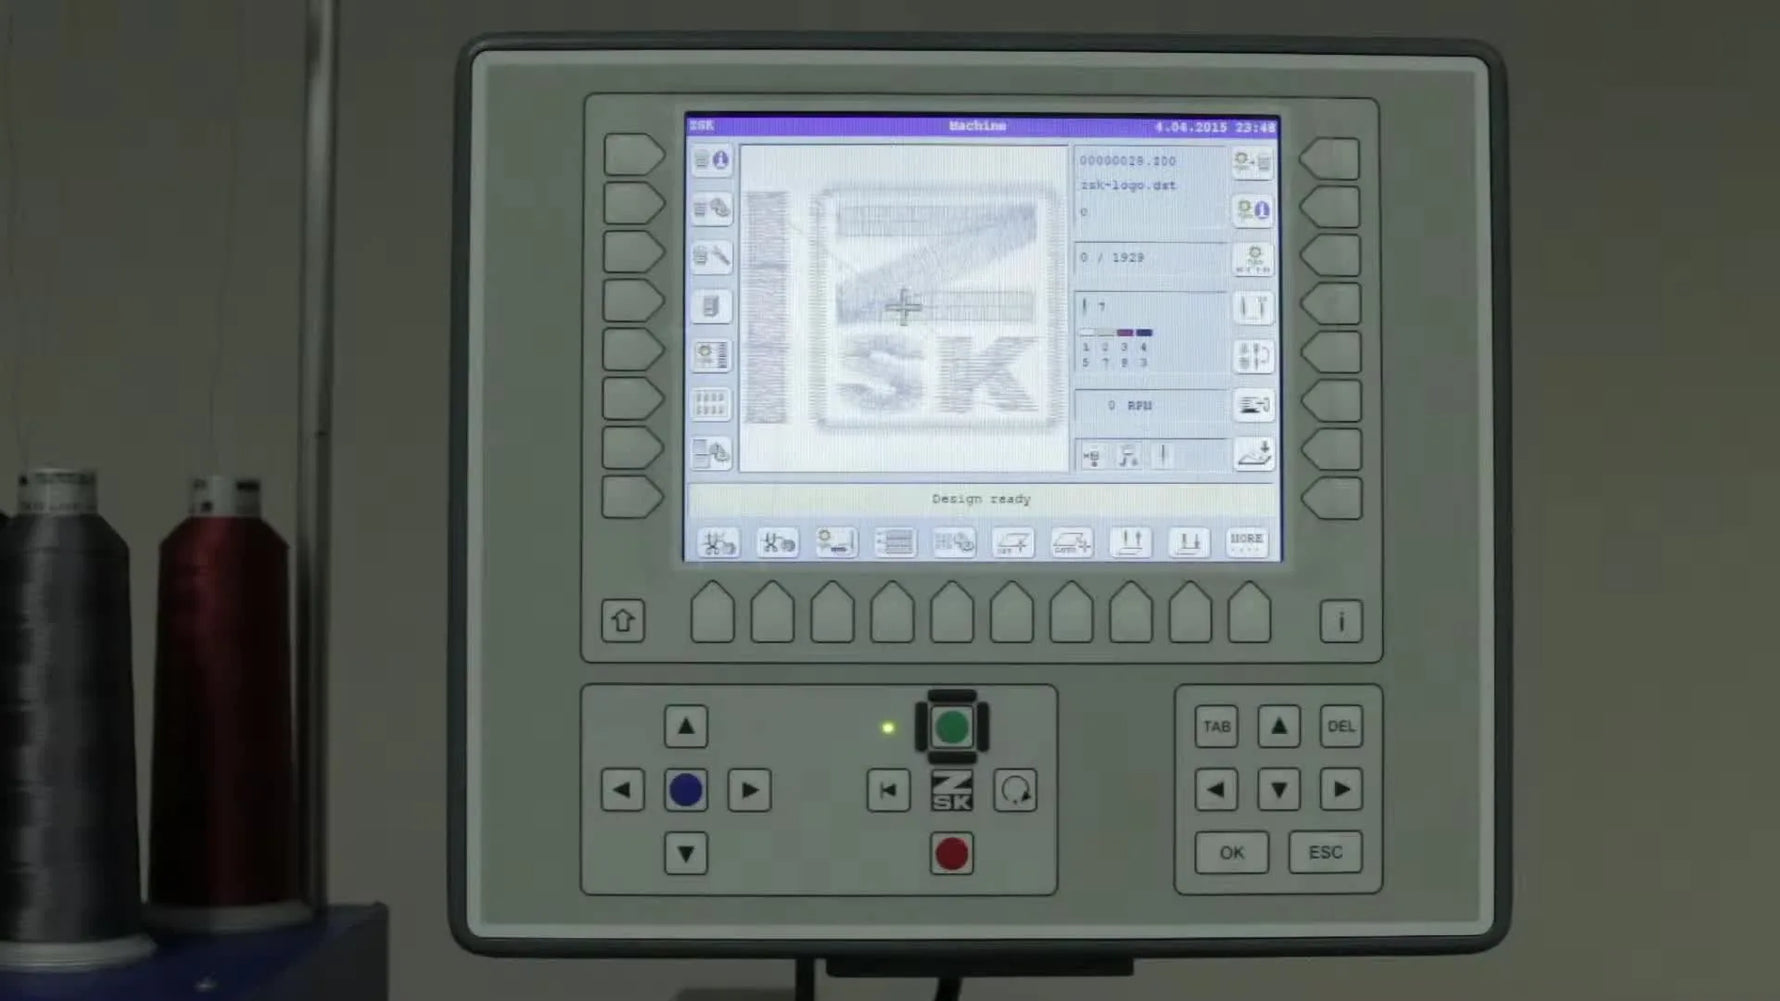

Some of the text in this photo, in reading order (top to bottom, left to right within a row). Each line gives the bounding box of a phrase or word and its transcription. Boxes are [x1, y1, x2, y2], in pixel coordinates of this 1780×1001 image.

[949, 120, 1007, 132] Machine
[1080, 179, 1177, 193] zsk-logo.dst
[1080, 252, 1088, 263] 0
[1108, 400, 1153, 411] 0 RPM
[931, 493, 1032, 507] Design ready
[1204, 720, 1232, 733] TAB
[1328, 720, 1356, 733] DEL
[1219, 845, 1246, 860] OK
[1309, 845, 1343, 860] ESC
